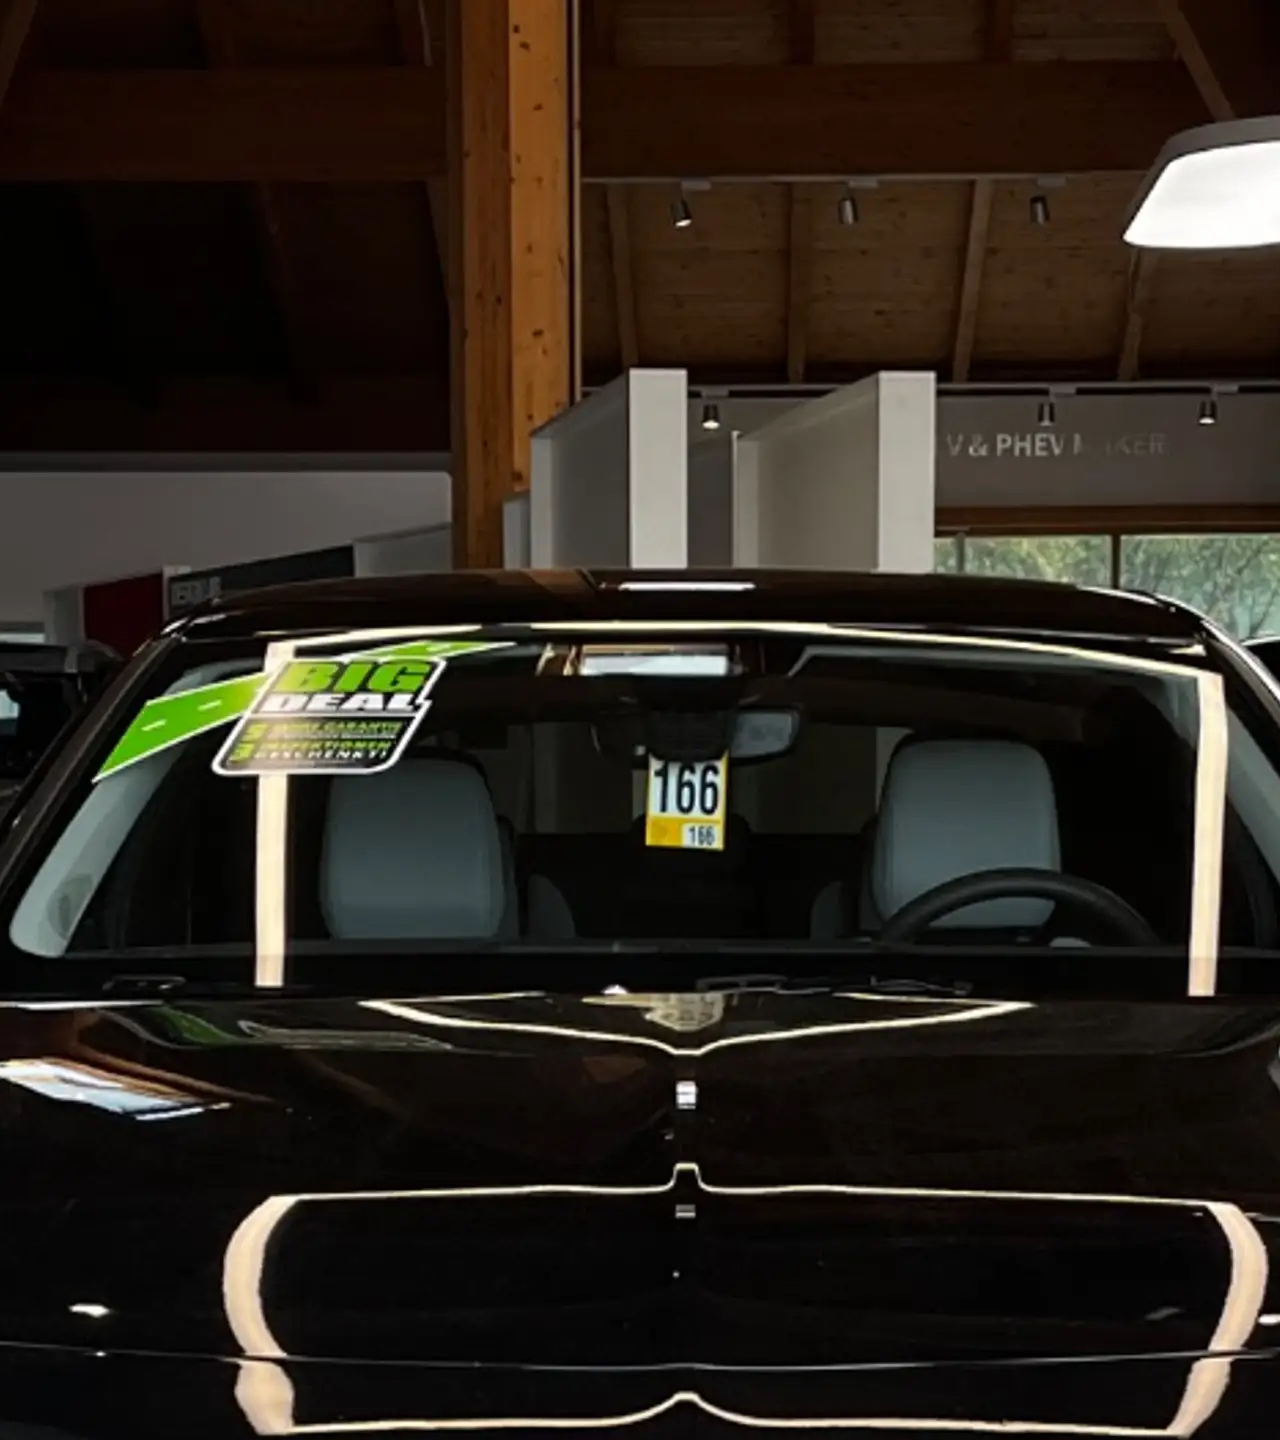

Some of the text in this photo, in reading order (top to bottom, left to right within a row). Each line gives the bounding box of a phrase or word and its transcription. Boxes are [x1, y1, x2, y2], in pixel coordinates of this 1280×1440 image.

[996, 433, 1065, 457] PHEV
[271, 661, 432, 693] BIG
[254, 693, 418, 712] DEAL
[654, 761, 719, 816] 166
